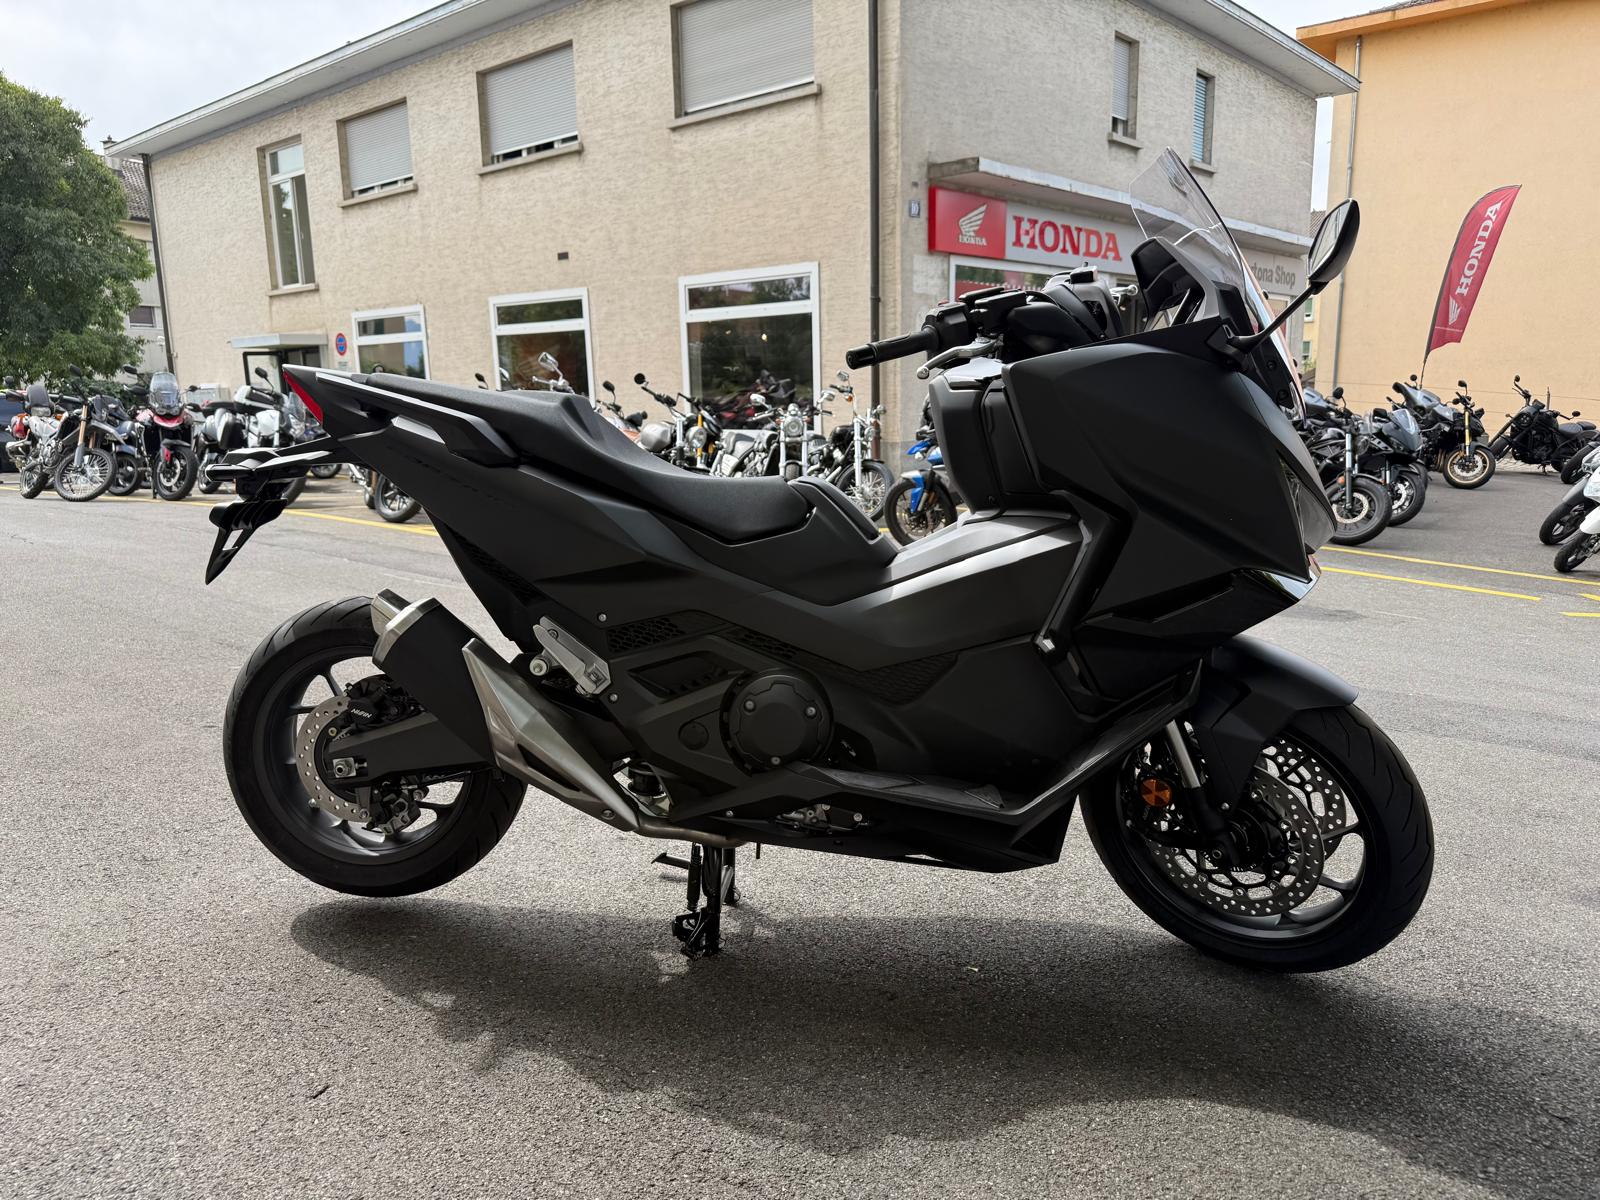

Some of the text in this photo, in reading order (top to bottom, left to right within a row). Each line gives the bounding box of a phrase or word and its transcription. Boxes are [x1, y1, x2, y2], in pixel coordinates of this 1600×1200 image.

[959, 234, 987, 246] HONDA
[1012, 215, 1122, 261] HONDA
[1455, 200, 1503, 296] HONDA
[1275, 265, 1296, 289] Shop
